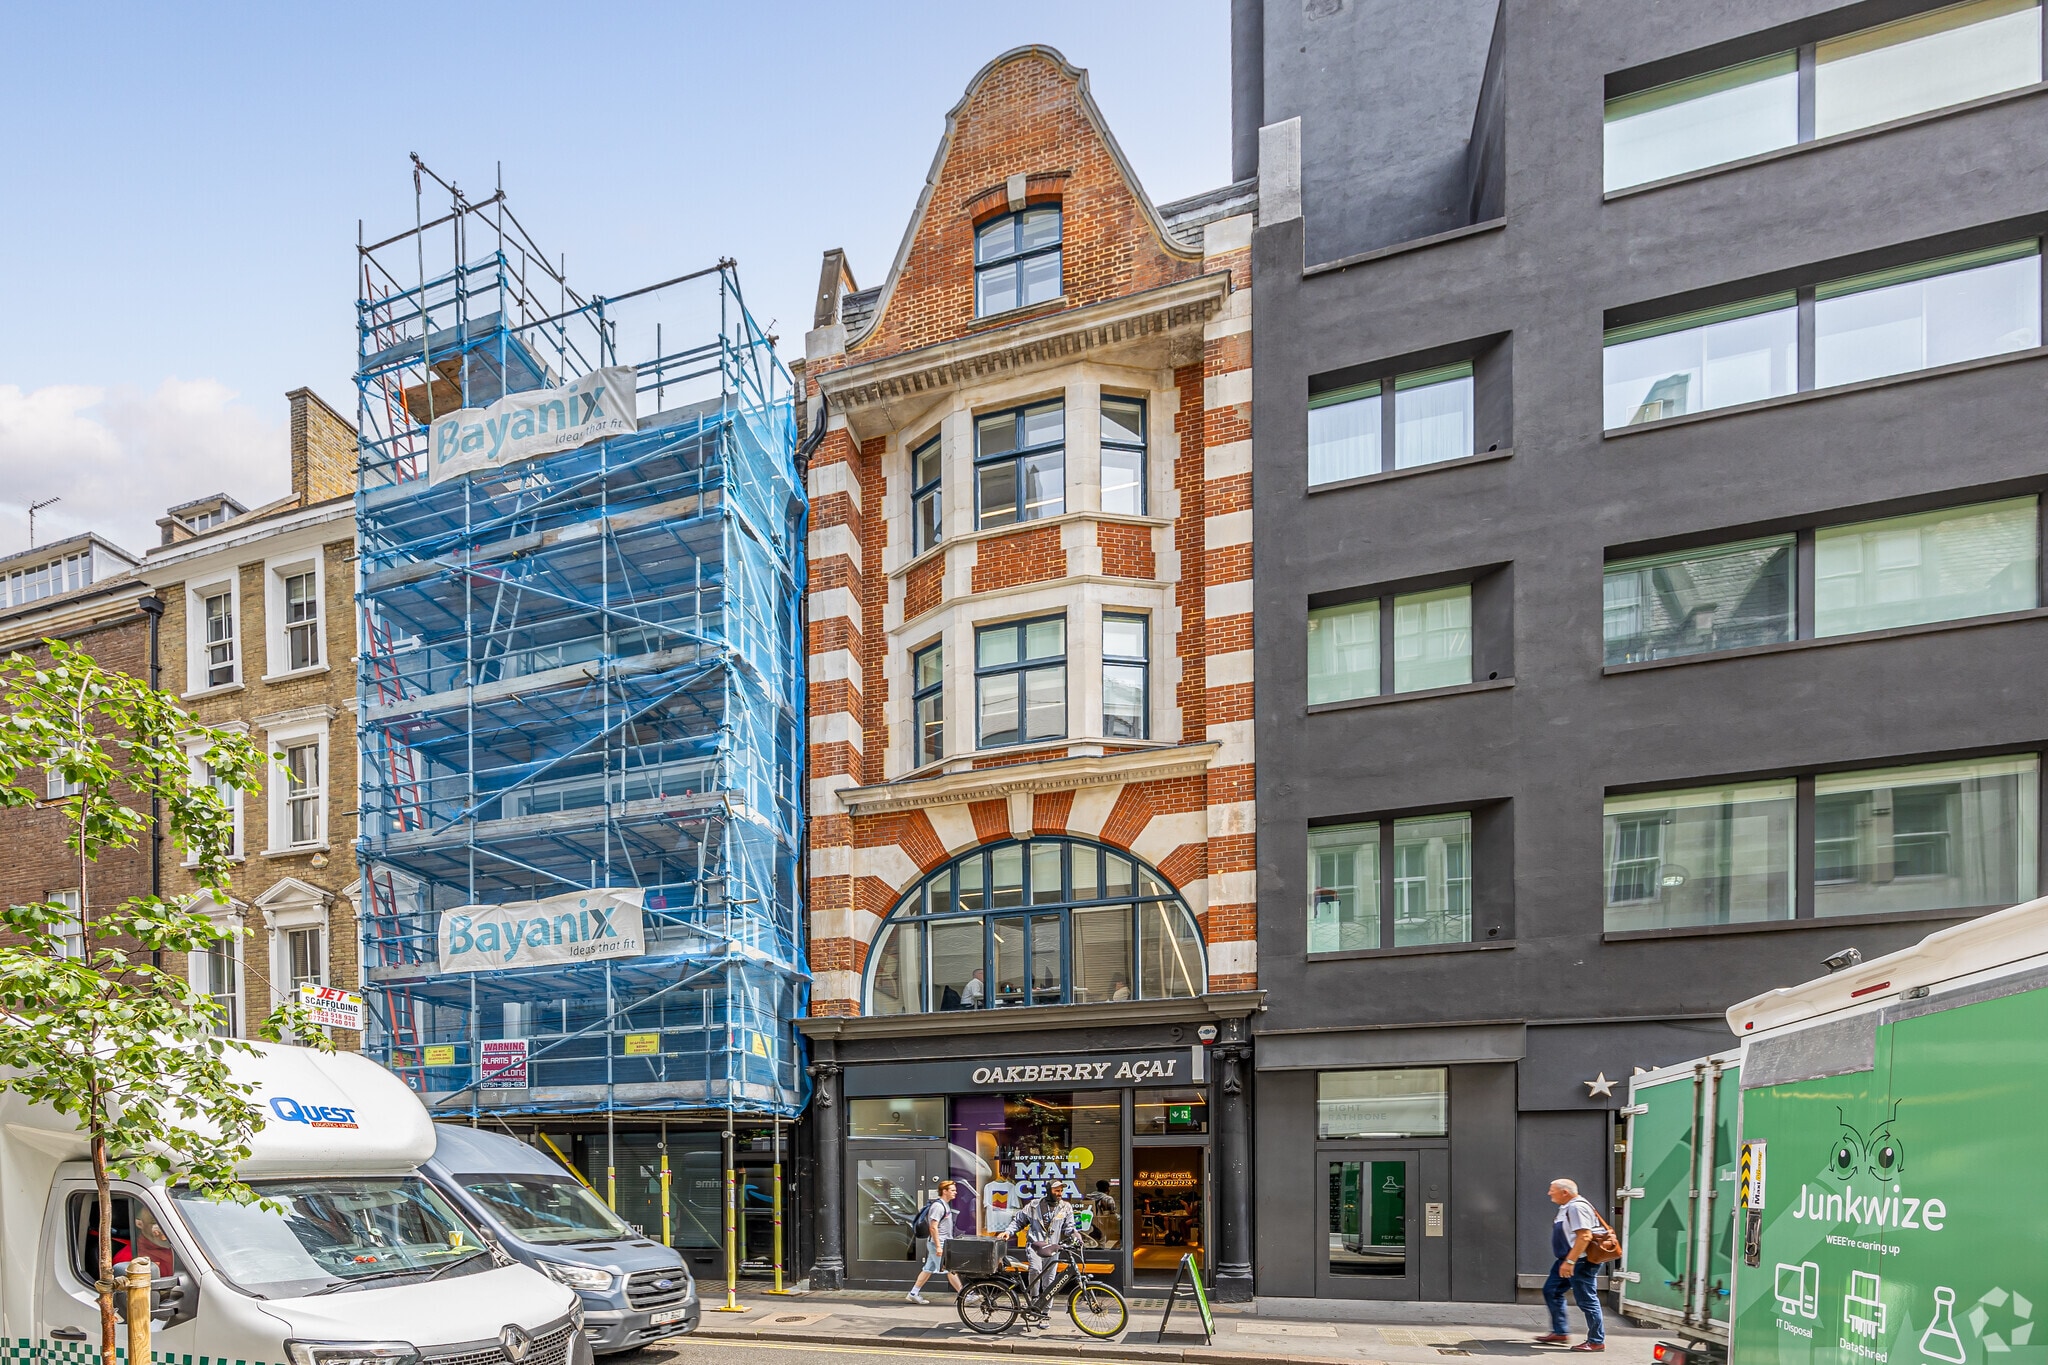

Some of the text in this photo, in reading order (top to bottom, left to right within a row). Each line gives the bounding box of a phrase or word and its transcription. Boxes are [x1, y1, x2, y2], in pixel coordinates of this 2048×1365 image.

[437, 384, 606, 464] Bayanix
[450, 898, 618, 962] Bayanix
[570, 938, 636, 956] Ideas that fit
[317, 986, 347, 1002] JET
[305, 996, 358, 1012] SCAFFOLDING
[309, 1008, 329, 1017] 1923
[1171, 1026, 1184, 1042] 9
[484, 1042, 525, 1051] WARNING
[972, 1060, 1177, 1084] OAKBERRY AÇAI
[408, 1077, 417, 1090] 3
[892, 1112, 900, 1122] 9
[1014, 1162, 1080, 1179] MAT
[1792, 1184, 1946, 1231] Junkwize
[1889, 1245, 1900, 1256] up
[1050, 1274, 1069, 1296] zoomo
[1776, 1318, 1813, 1338] IT Disposal
[1840, 1338, 1888, 1364] DataShred
